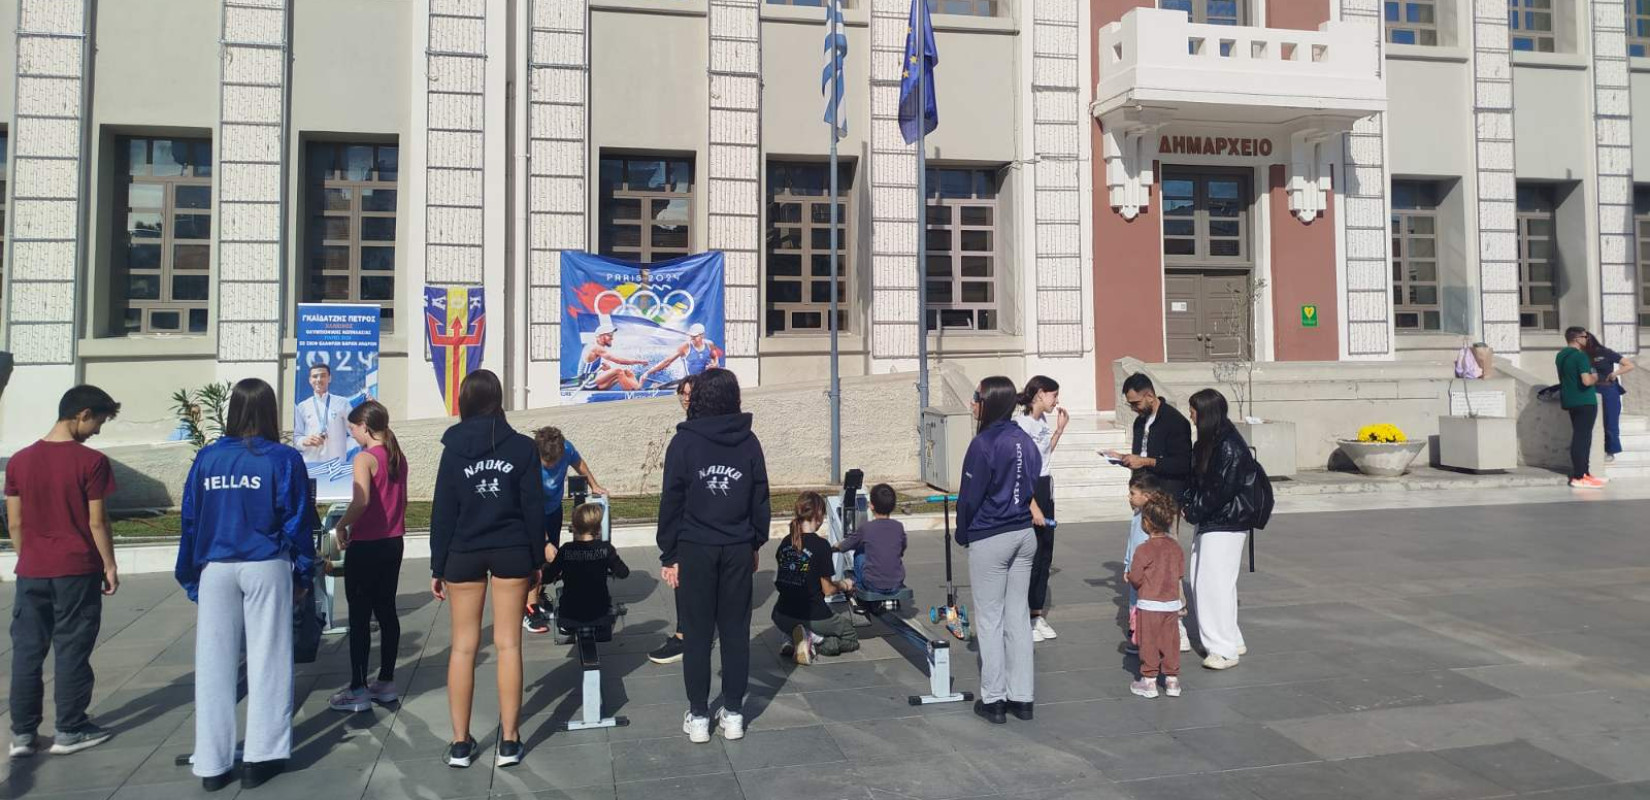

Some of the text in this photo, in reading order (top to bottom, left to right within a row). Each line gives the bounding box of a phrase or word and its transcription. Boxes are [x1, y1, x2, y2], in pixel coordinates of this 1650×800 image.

[1159, 135, 1272, 157] ΔΗΜΑΡΧΕΙΟ
[606, 273, 680, 282] PARIS 2024
[347, 315, 376, 323] ΠΕΤΡΟΣ
